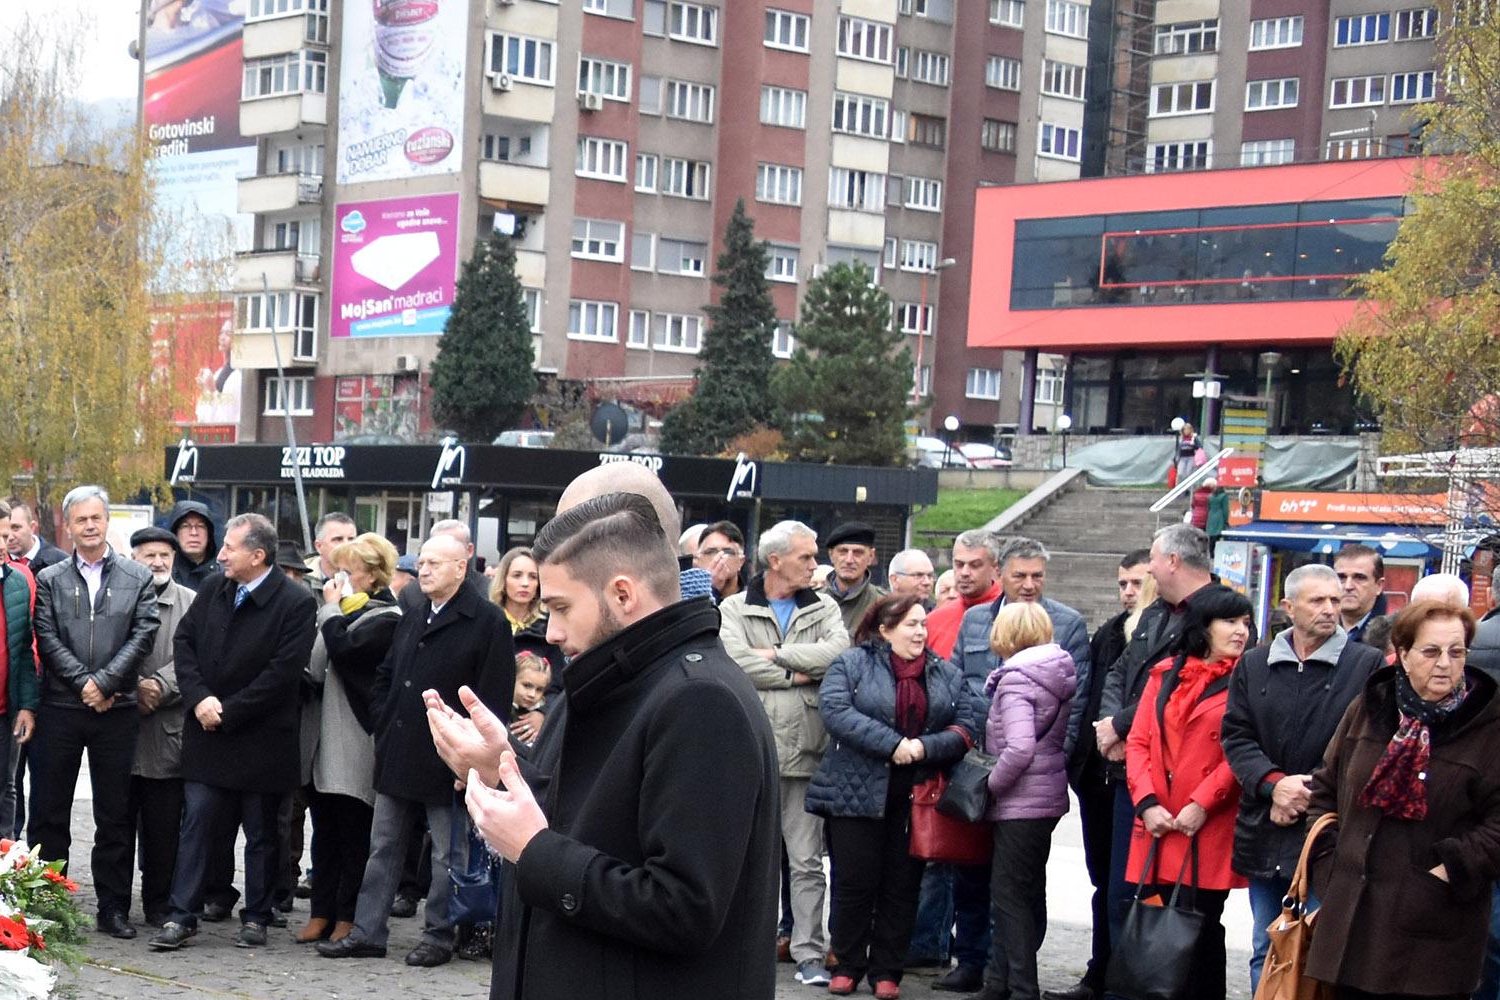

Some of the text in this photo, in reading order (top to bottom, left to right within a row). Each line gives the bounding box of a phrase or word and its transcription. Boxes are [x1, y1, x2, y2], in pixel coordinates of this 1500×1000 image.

[149, 116, 215, 140] Gotovinski
[394, 286, 443, 309] madraci
[281, 447, 346, 466] ZZI TOP
[301, 467, 345, 478] SLADOLEDA
